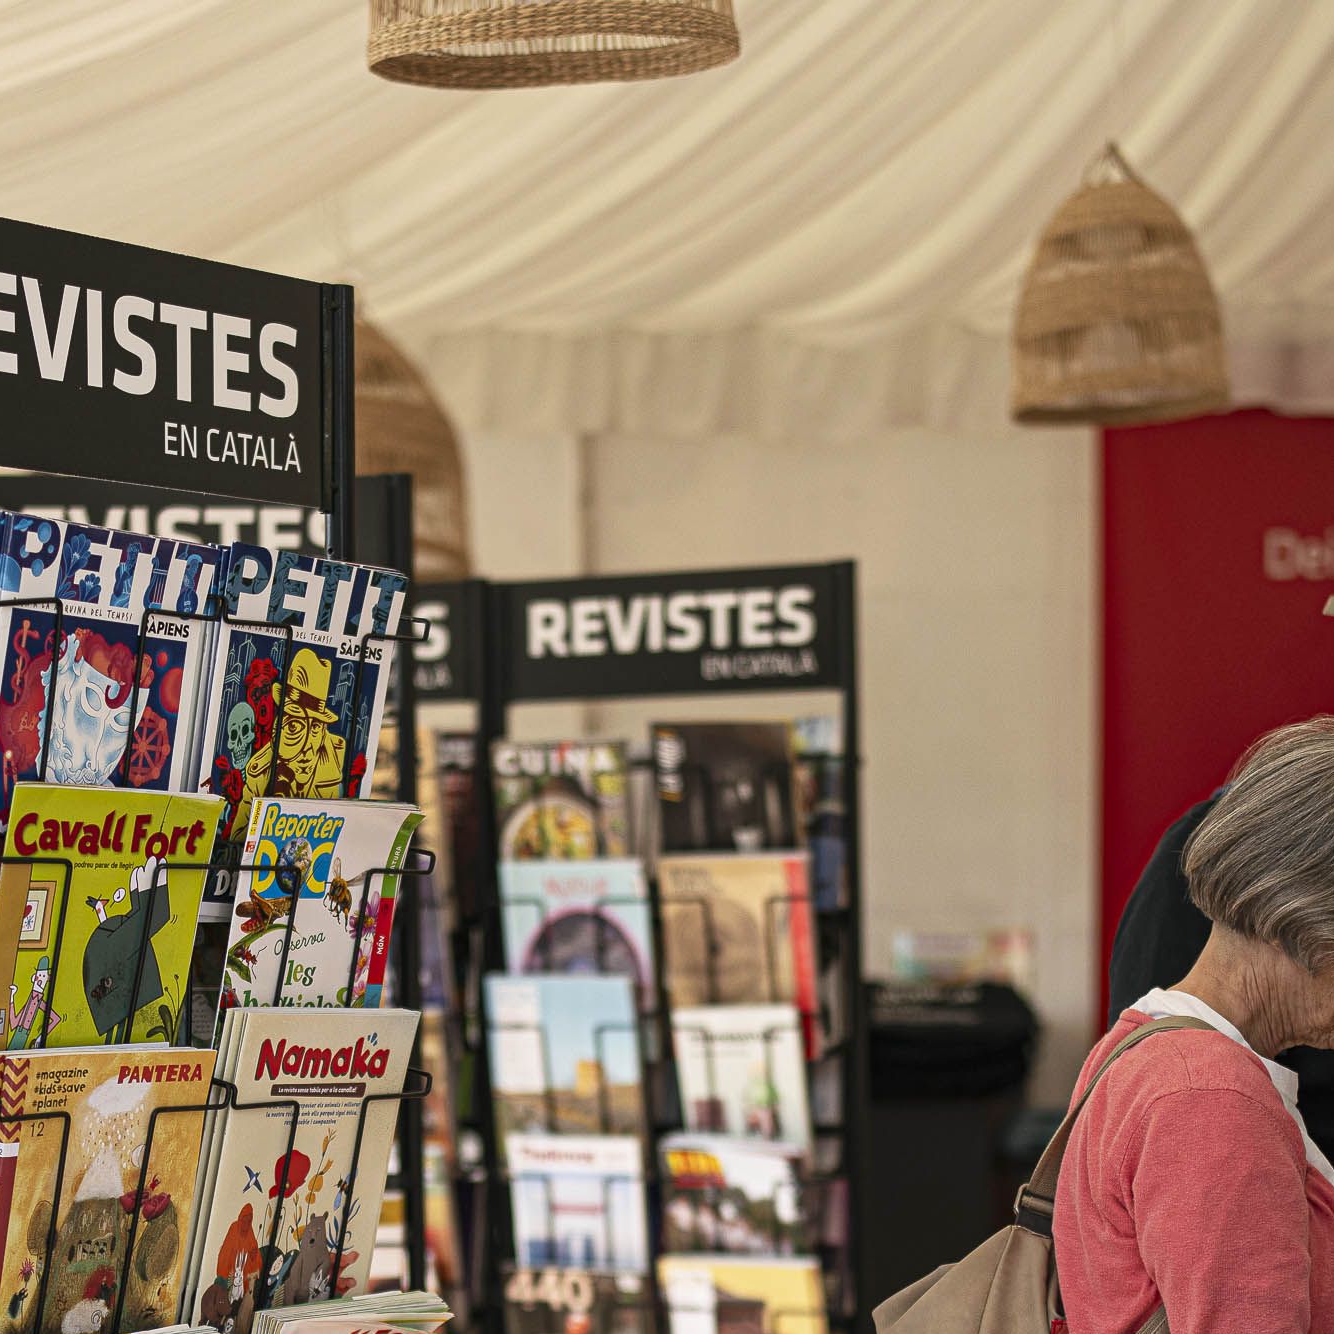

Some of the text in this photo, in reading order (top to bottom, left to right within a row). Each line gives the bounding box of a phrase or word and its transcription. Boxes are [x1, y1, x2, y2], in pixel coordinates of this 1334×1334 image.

[164, 421, 301, 474] EN CATALÀ
[5, 512, 224, 613] PETIT
[229, 541, 409, 640] PETIT
[526, 587, 817, 659] REVISTES
[339, 639, 383, 662] SÀPENS
[262, 803, 344, 840] Reporter
[14, 810, 205, 862] Cavall Fort
[274, 932, 326, 956] Oserva
[376, 935, 385, 955] MÓN
[284, 960, 317, 986] les
[254, 1036, 391, 1081] Namaka
[35, 1067, 89, 1081] #magazine
[117, 1063, 203, 1084] PANTERA
[33, 1081, 86, 1096] #kids#save
[32, 1096, 67, 1110] #planet
[30, 1122, 44, 1137] 12
